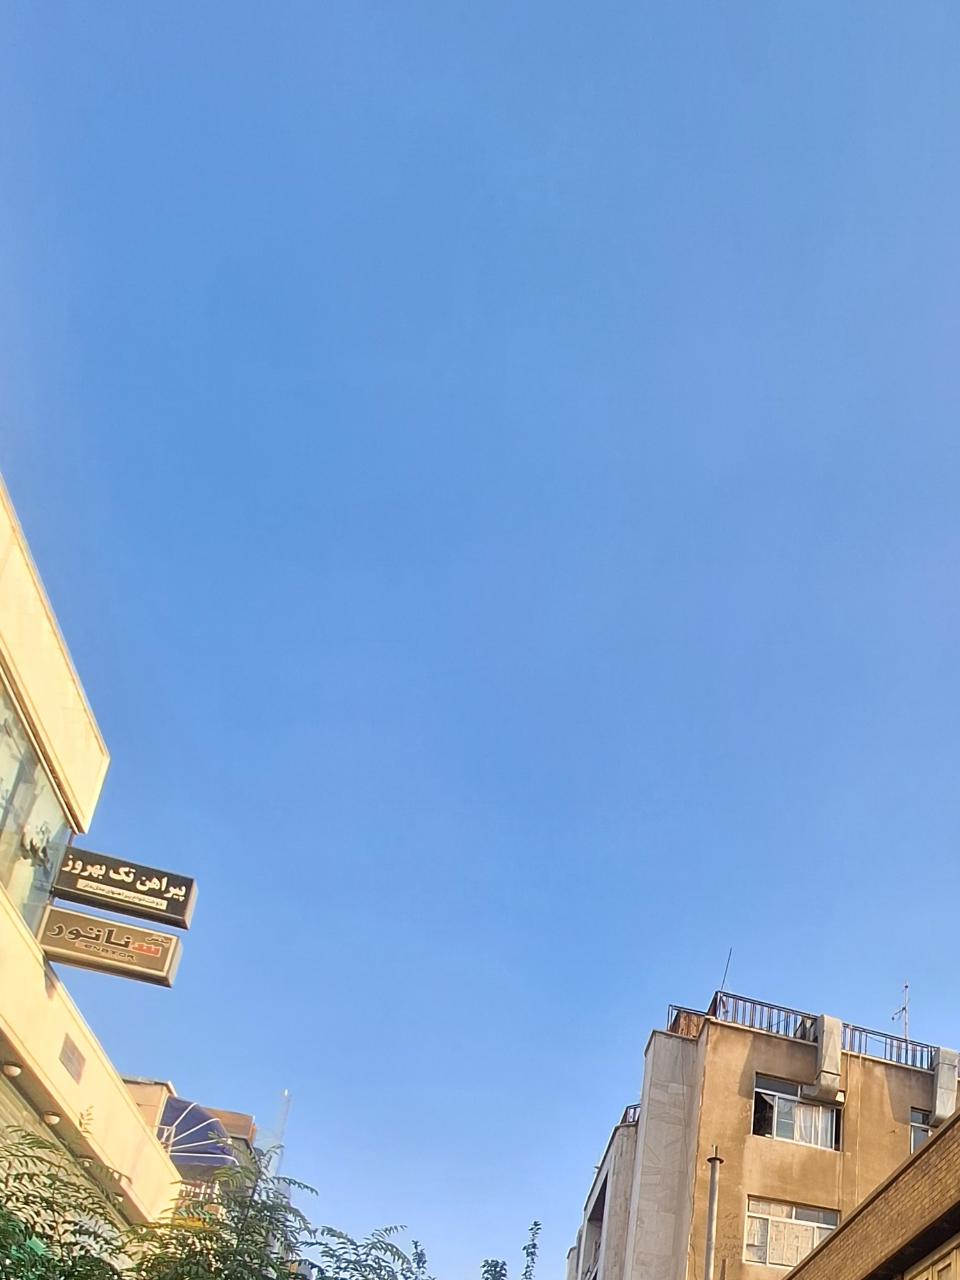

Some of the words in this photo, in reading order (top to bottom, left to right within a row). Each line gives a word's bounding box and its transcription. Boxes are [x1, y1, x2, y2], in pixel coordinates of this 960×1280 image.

[62, 855, 106, 879] بهروز
[109, 866, 136, 883] تک
[135, 876, 186, 901] پیراهن
